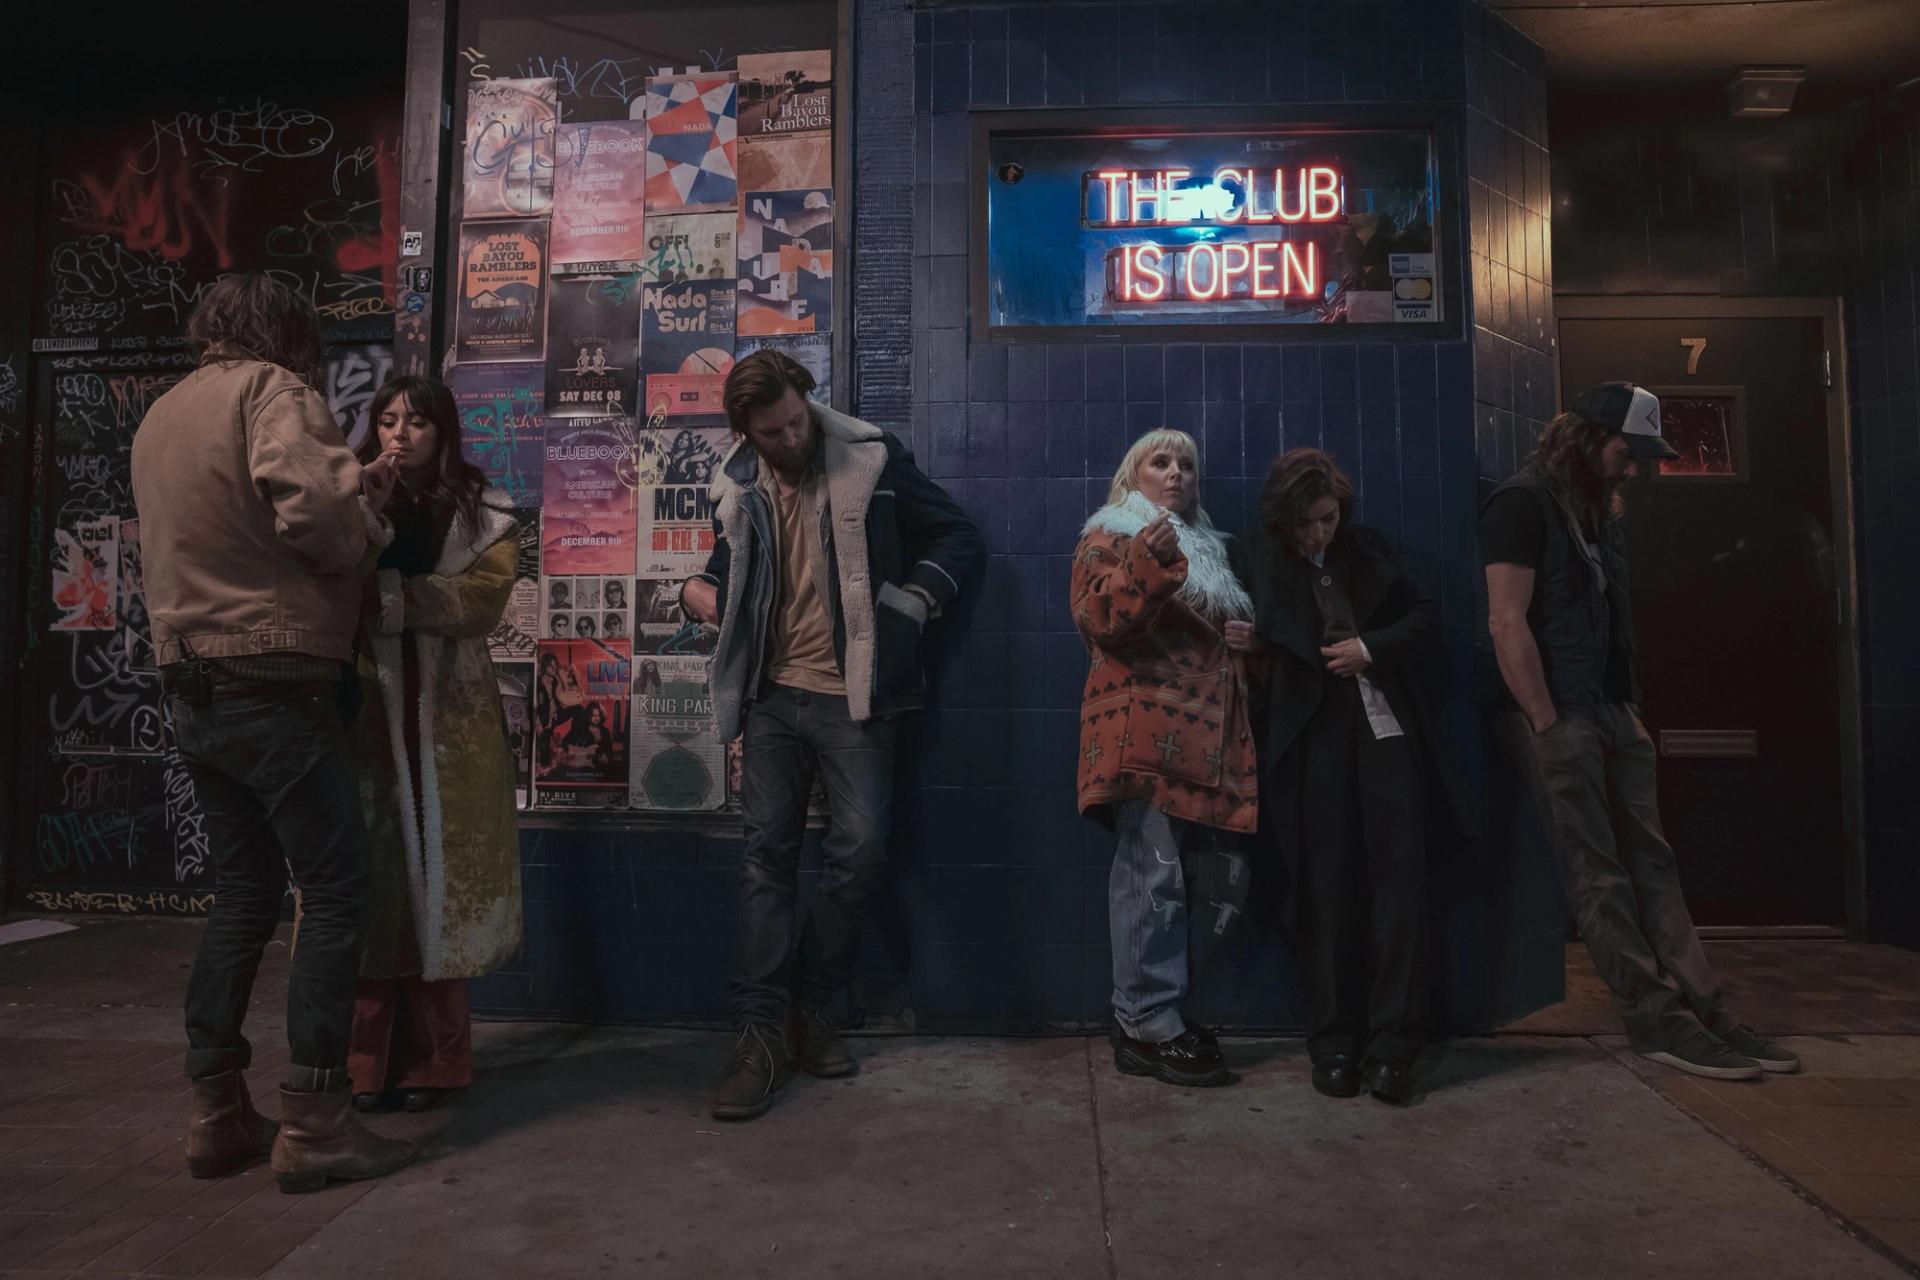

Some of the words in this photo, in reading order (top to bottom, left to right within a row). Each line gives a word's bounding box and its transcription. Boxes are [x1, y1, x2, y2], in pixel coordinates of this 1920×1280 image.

[793, 95, 827, 107] Lost
[781, 104, 827, 119] Bayou
[683, 122, 713, 132] NADA
[761, 115, 832, 132] Ramblers
[1099, 168, 1191, 224] THE
[1213, 166, 1340, 222] CLUB
[570, 225, 614, 236] DECEMBER
[489, 241, 520, 252] LOST
[648, 234, 689, 251] OFF!
[483, 252, 525, 263] BAYOU
[469, 261, 537, 273] RAMBLERS
[1124, 243, 1165, 299] IS
[1186, 241, 1315, 299] OPEN
[643, 286, 707, 310] Nada
[658, 310, 707, 333] Surf
[1401, 310, 1428, 319] VISA
[1680, 337, 1707, 376] 7
[567, 377, 616, 389] LOVERS
[559, 390, 580, 402] SAT
[583, 390, 603, 402] DEC
[606, 390, 621, 401] 08
[546, 445, 635, 461] BLUEBOOK
[561, 537, 606, 546] DECEMBER
[607, 537, 622, 546] 9th
[587, 660, 630, 682] LIVE
[639, 698, 677, 713] KING
